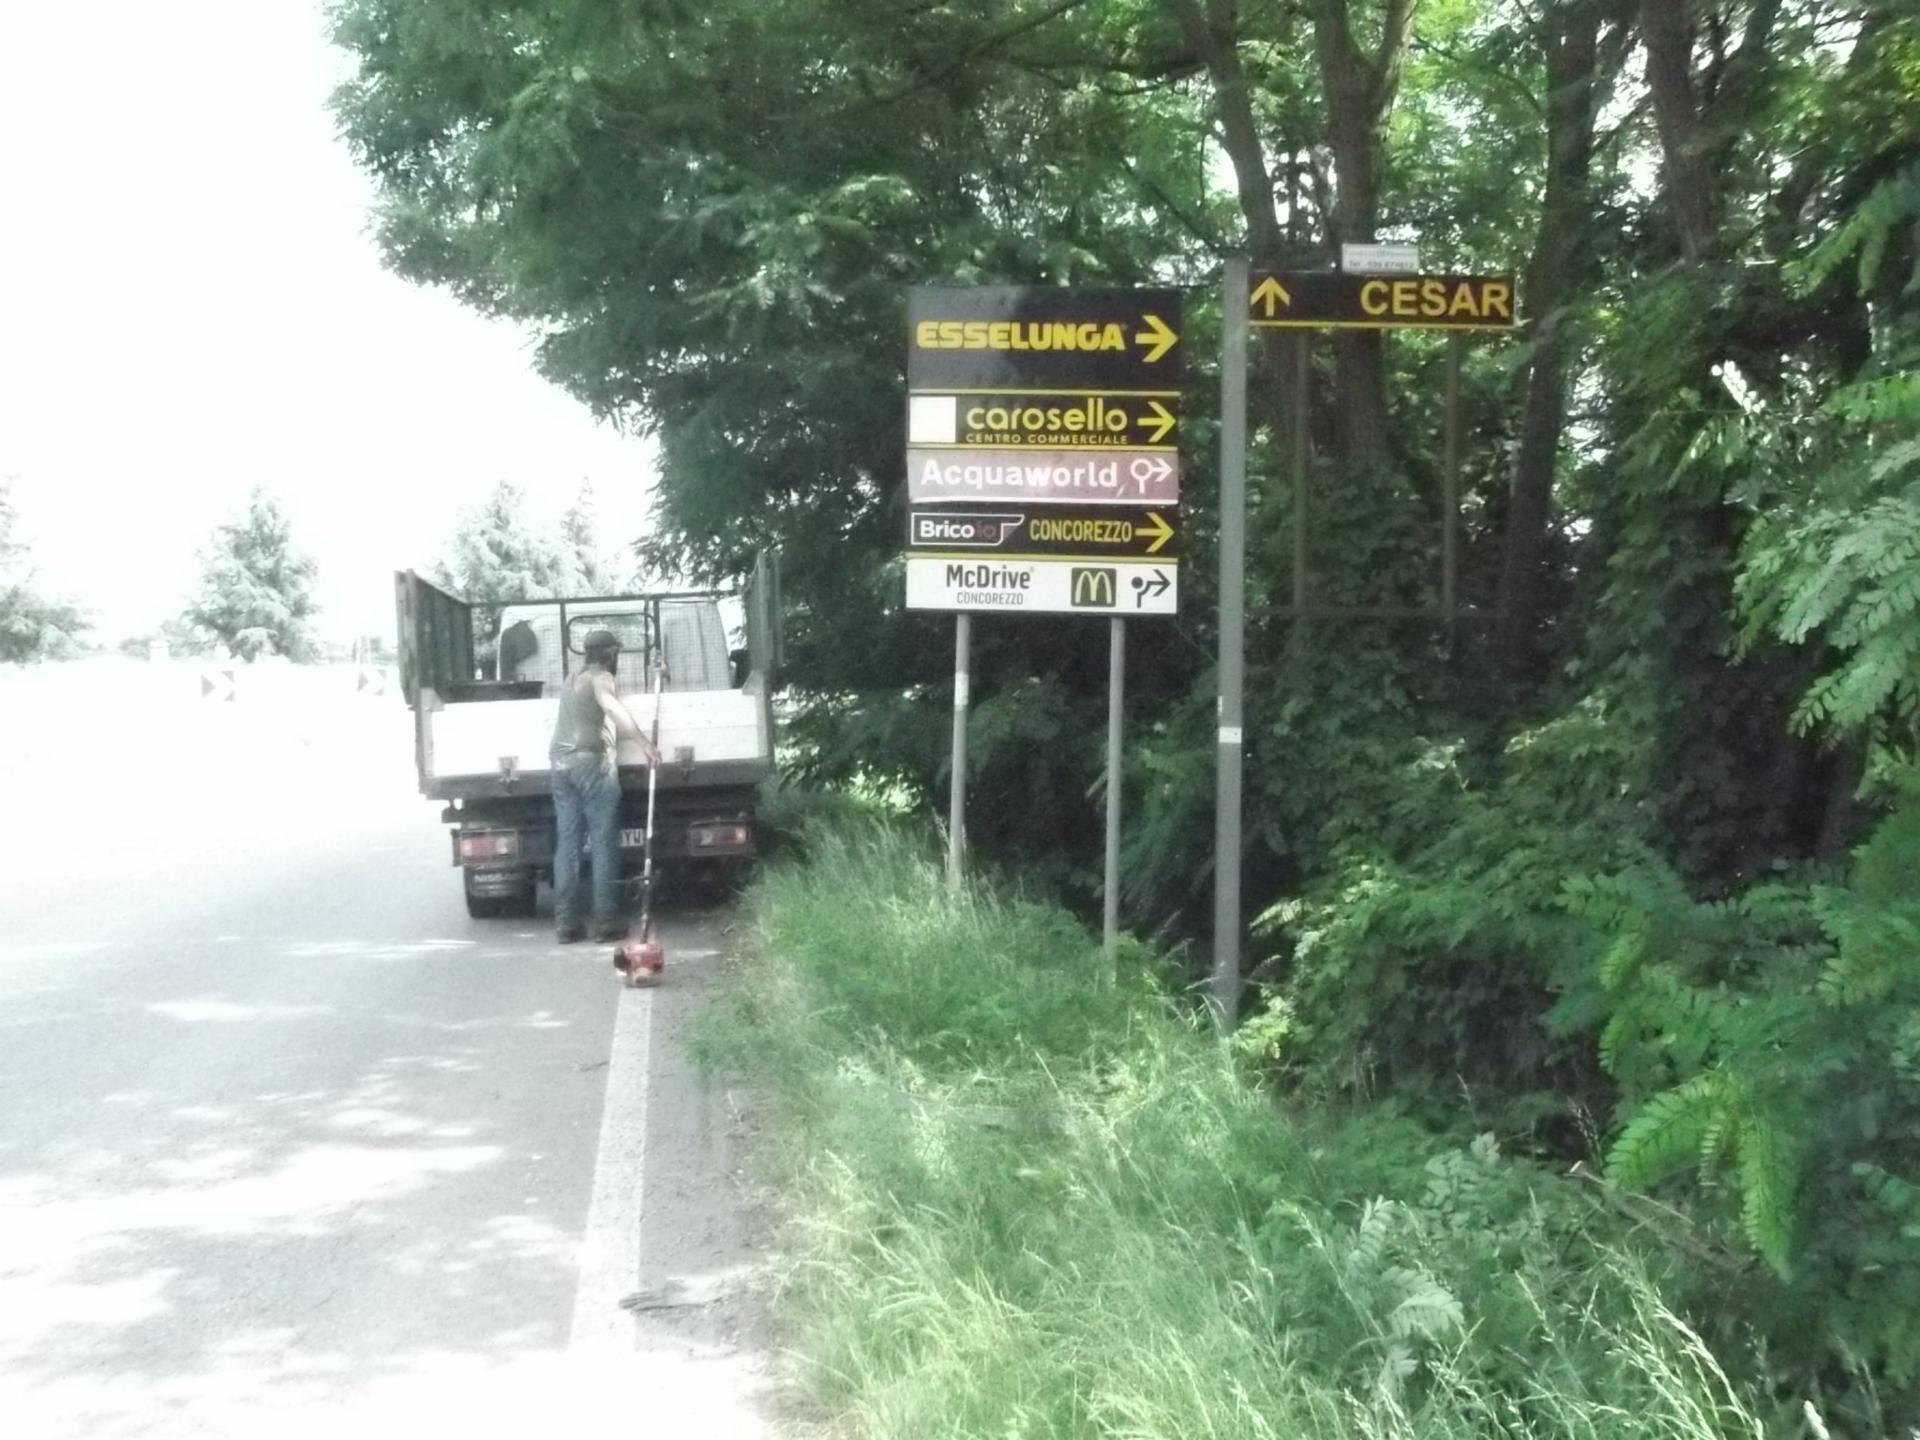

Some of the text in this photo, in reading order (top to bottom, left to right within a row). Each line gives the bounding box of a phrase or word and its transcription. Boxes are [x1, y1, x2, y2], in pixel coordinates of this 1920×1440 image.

[1360, 280, 1511, 317] CESAR
[916, 321, 1126, 350] ESSELUNGA
[966, 398, 1128, 431] carosello
[966, 433, 1128, 445] CENTRO COMMERCIALE
[920, 458, 1118, 490] Acquaworld
[1029, 519, 1132, 543] CONCOREZZO
[946, 564, 1031, 590] McDrive
[956, 592, 1024, 606] CONCOREZZO
